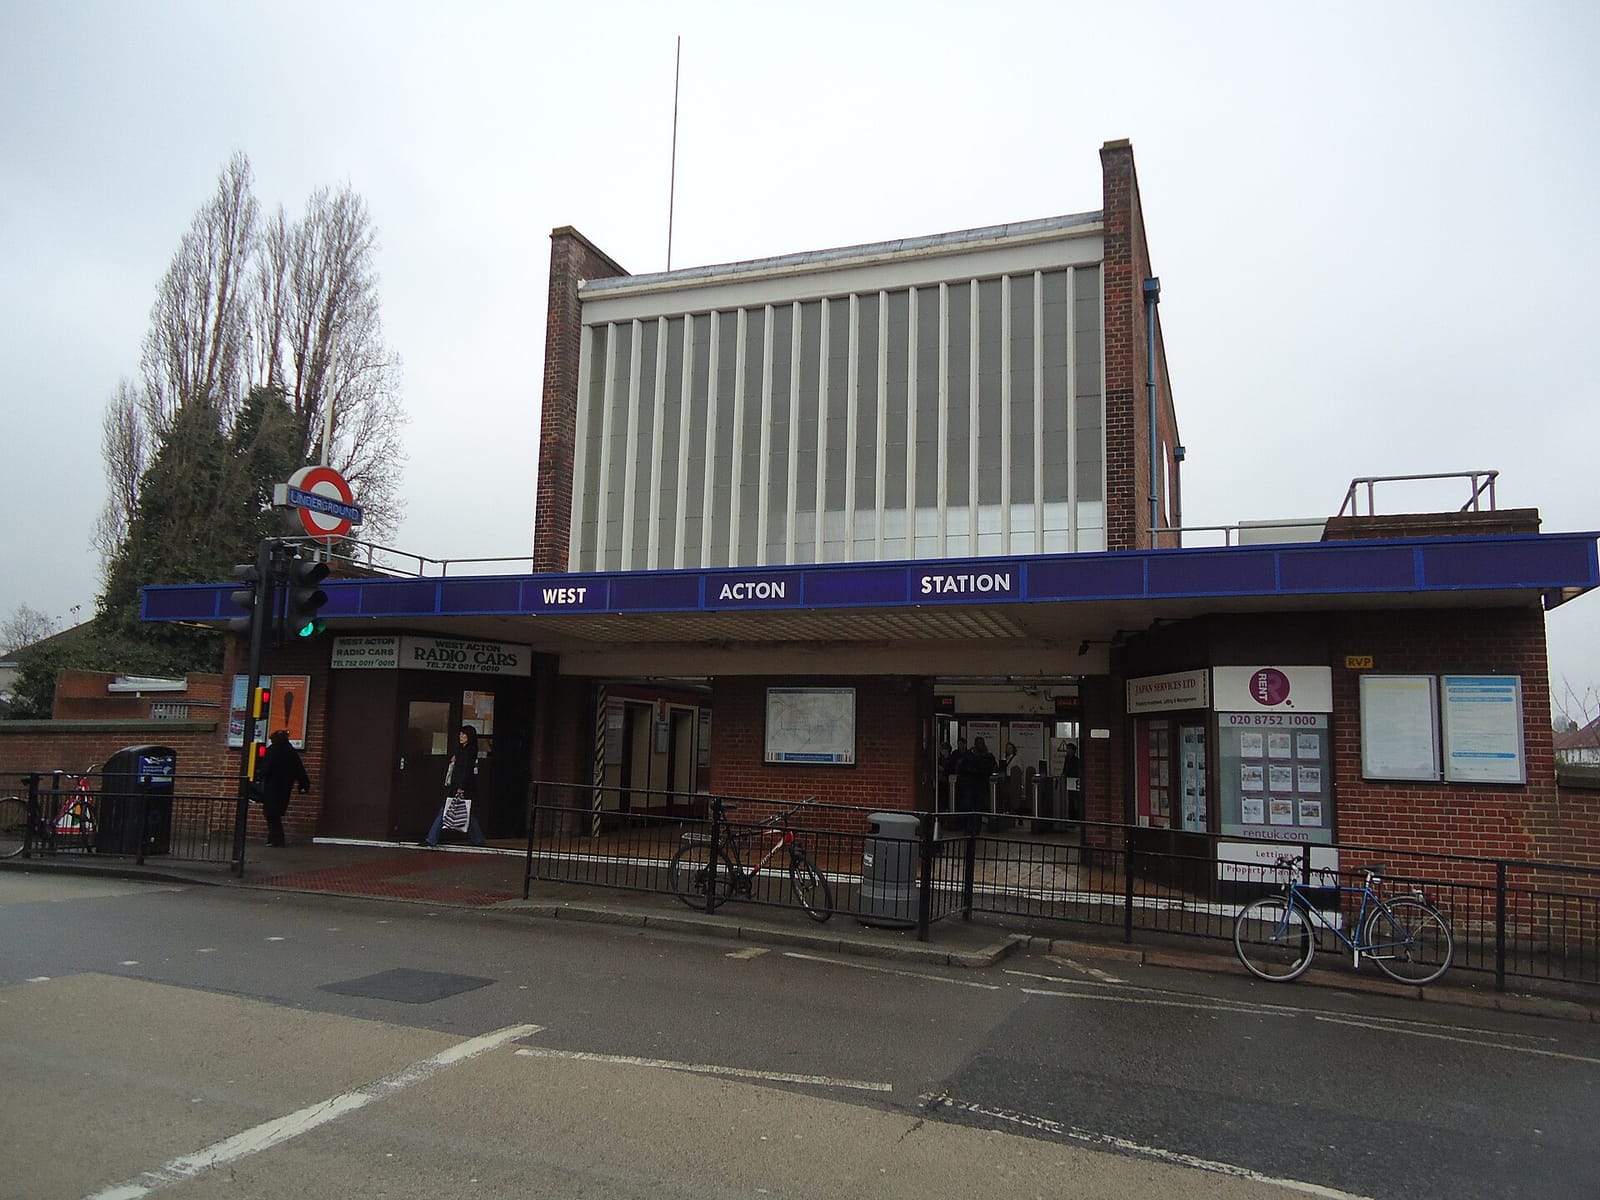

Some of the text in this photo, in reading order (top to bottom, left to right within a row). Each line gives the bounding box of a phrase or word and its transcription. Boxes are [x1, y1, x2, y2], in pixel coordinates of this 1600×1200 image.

[290, 490, 359, 520] UNDERGROUND
[543, 573, 1010, 604] WEST ACTON STATION
[339, 638, 363, 646] WEST
[436, 640, 501, 652] WEST ACTON
[336, 648, 394, 656] RADIO CARS
[414, 647, 518, 667] RADIO CARS
[1348, 657, 1371, 667] RVP
[1258, 673, 1268, 702] RENT
[1230, 714, 1317, 727] 020 8752 1000
[1243, 829, 1309, 841] rentuk.com
[1256, 850, 1293, 860] Lettings
[1226, 865, 1267, 877] Property
